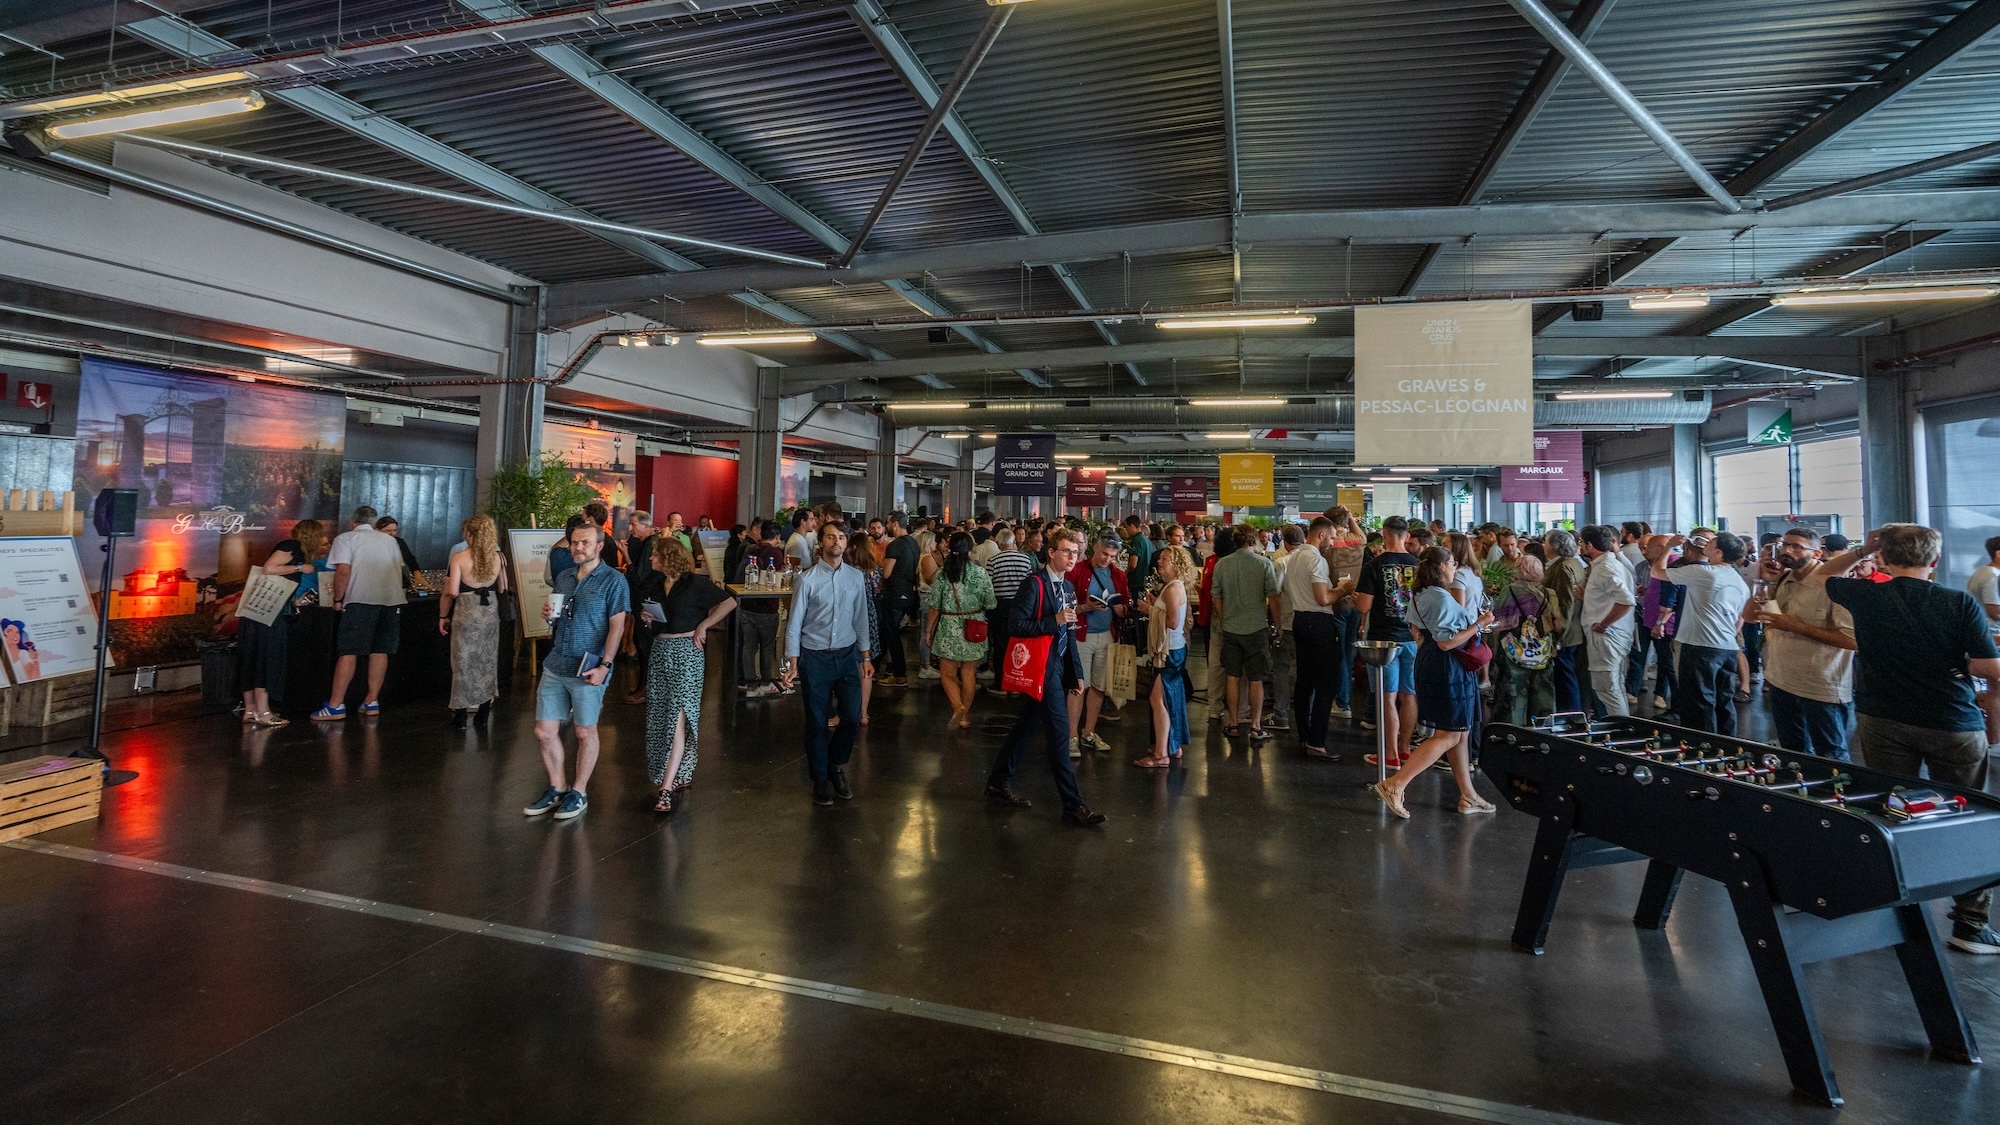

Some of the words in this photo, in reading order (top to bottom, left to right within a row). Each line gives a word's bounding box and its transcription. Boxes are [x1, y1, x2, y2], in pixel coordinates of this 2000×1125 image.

[1422, 325, 1461, 334] GRANDS
[1398, 379, 1468, 392] GRAVES
[1474, 378, 1486, 392] &
[1360, 396, 1527, 414] PESSAC-LÉOGNAN
